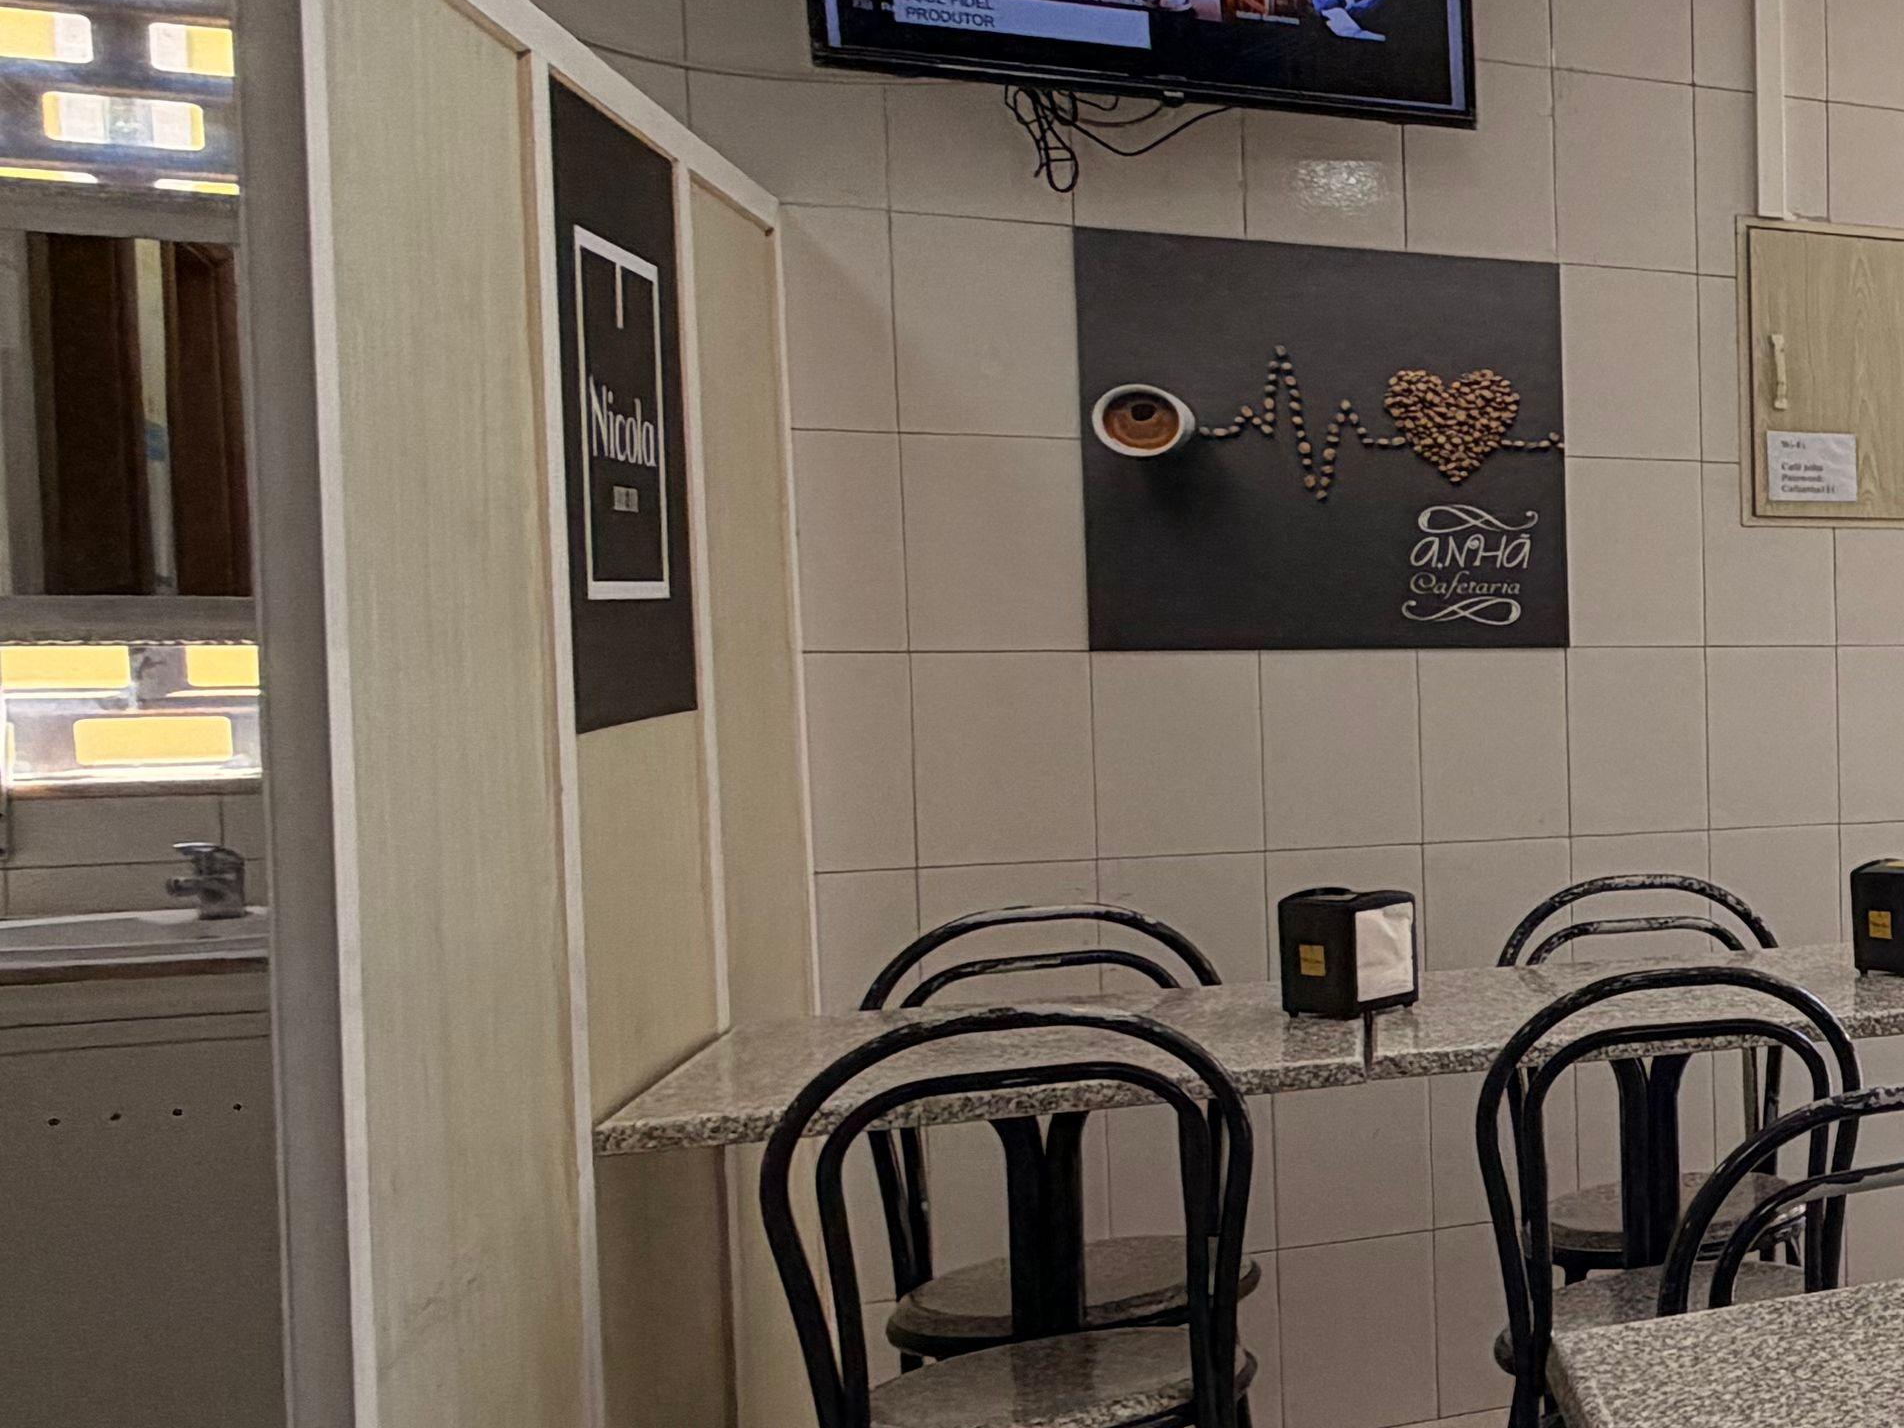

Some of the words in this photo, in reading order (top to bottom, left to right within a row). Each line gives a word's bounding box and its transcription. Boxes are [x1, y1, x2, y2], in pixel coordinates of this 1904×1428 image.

[905, 6, 996, 29] PRODUTOR
[589, 373, 657, 467] Nicola
[1409, 570, 1521, 600] Cafetaria
